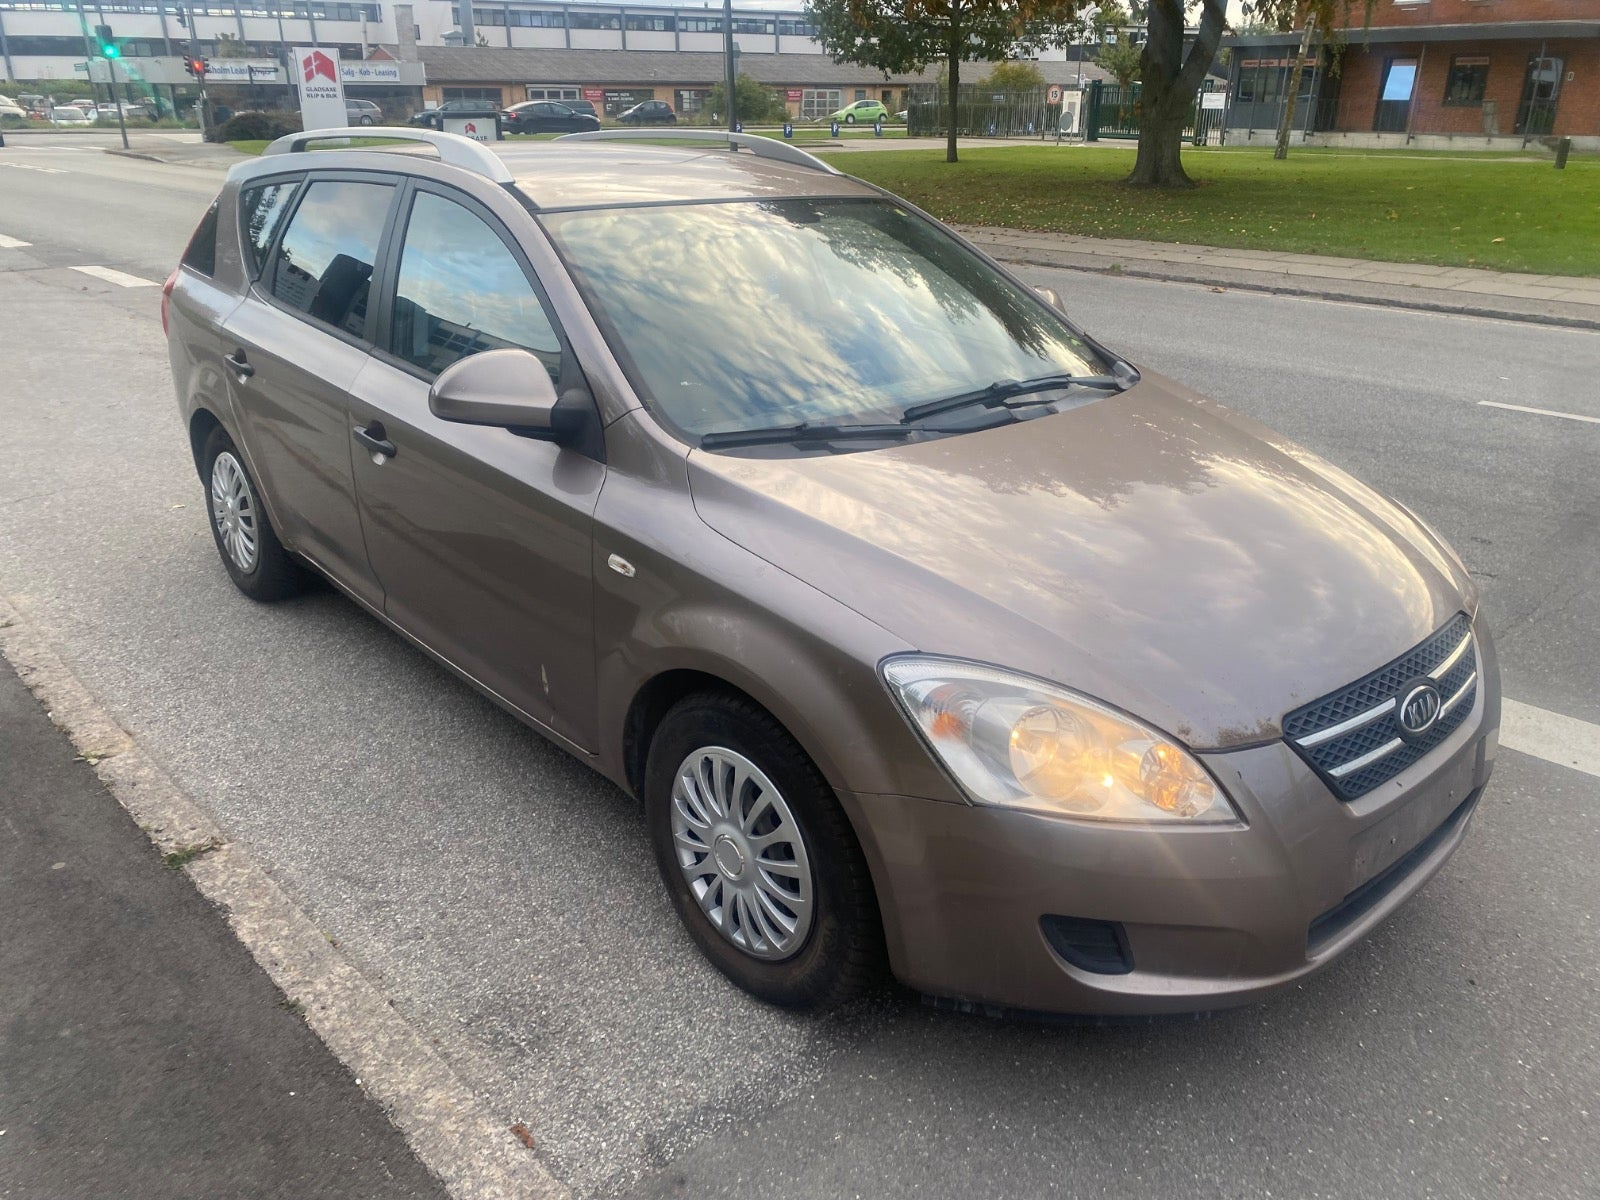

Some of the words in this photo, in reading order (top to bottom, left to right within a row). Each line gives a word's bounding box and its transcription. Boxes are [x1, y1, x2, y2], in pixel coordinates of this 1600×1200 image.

[231, 65, 256, 76] Leasig
[341, 68, 354, 77] Salg
[374, 68, 397, 78] Leasing
[786, 126, 791, 134] P
[1407, 693, 1437, 728] KIA
